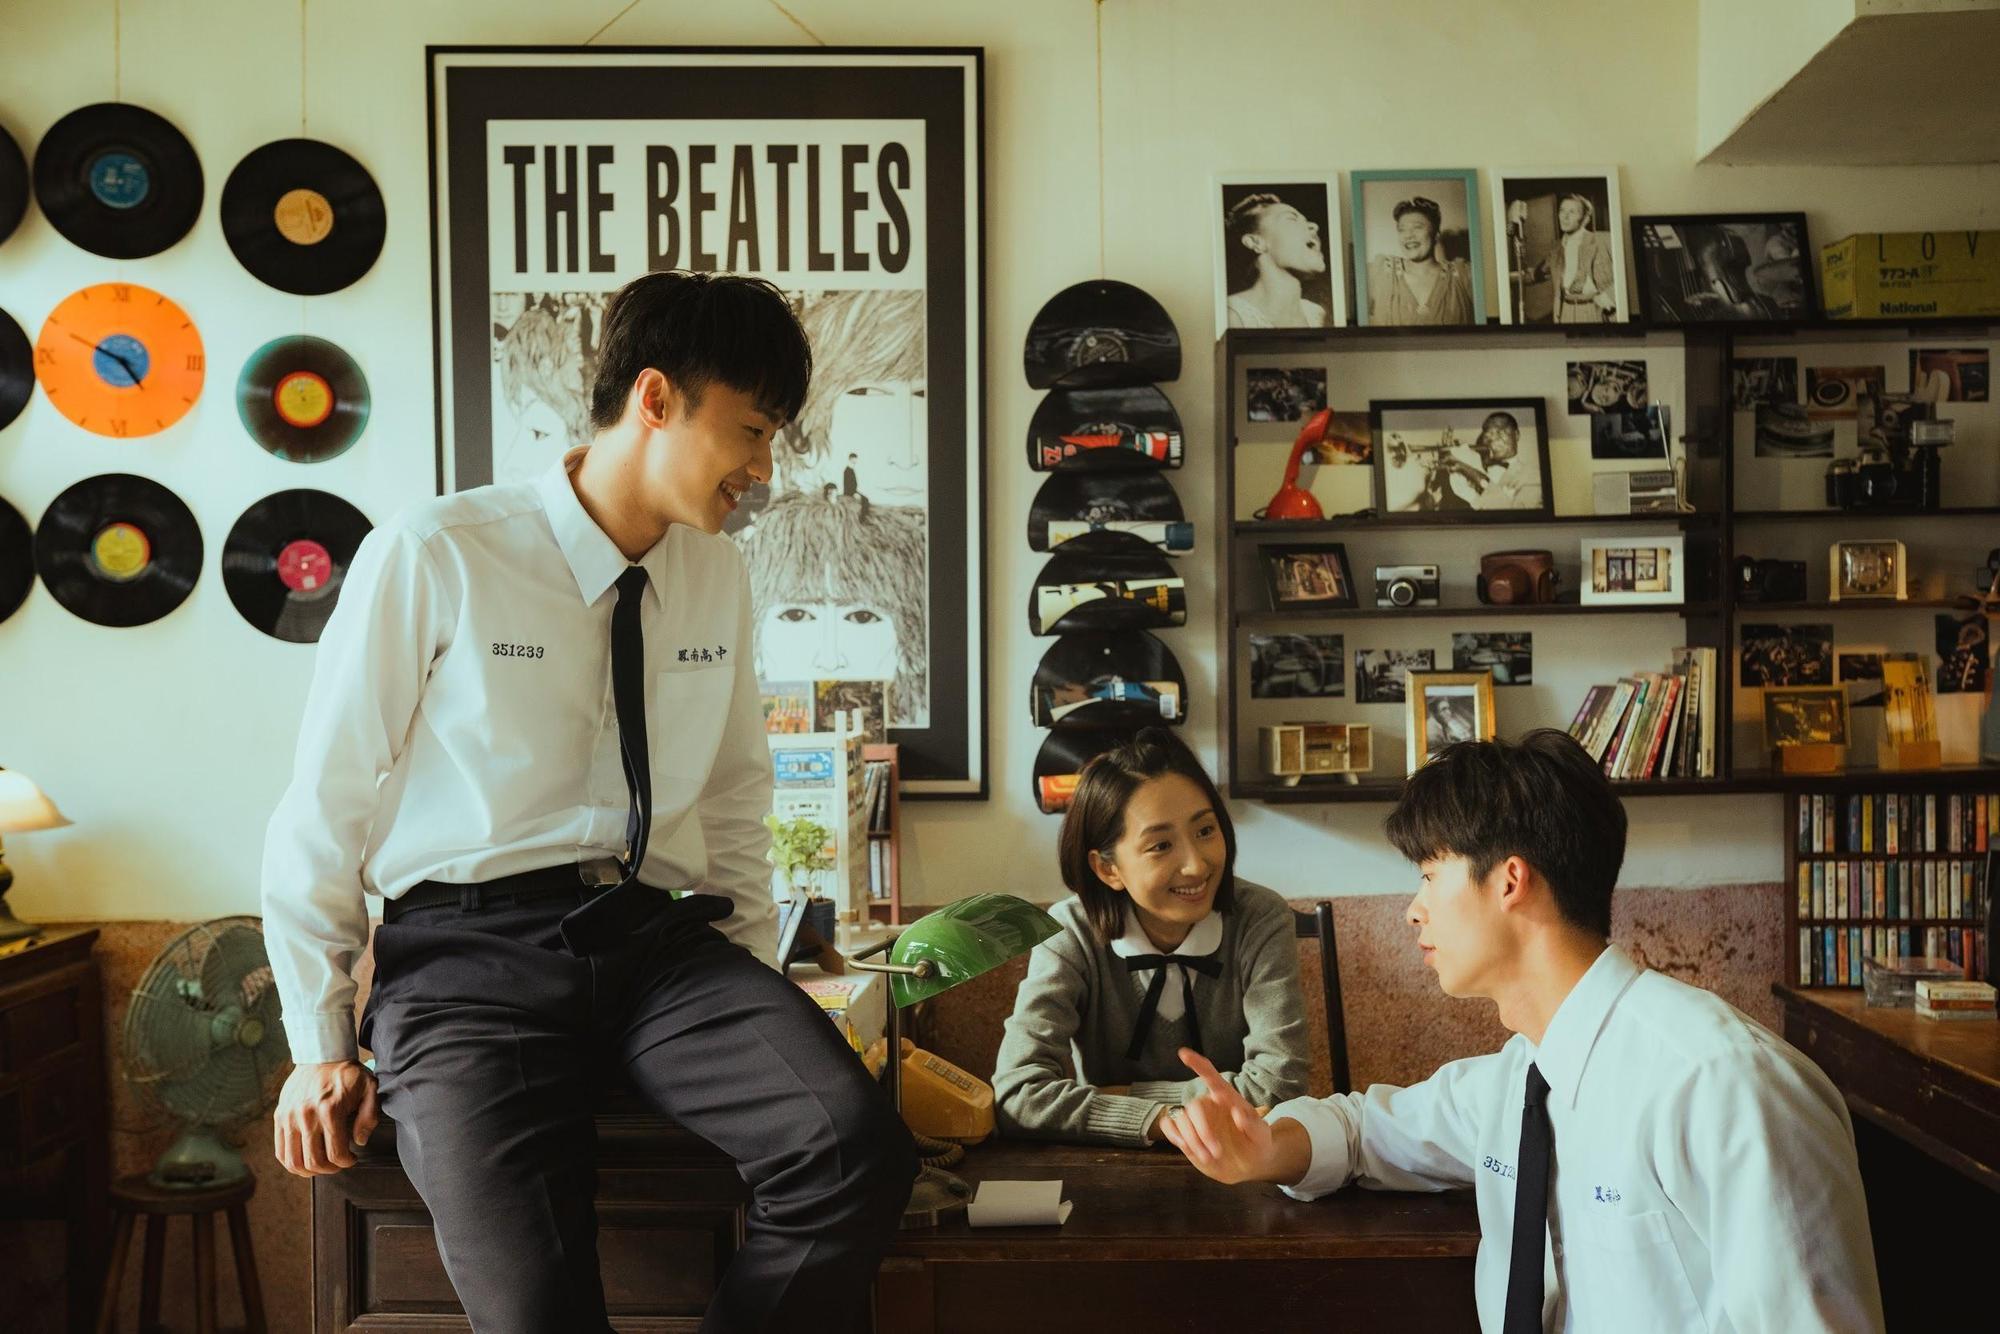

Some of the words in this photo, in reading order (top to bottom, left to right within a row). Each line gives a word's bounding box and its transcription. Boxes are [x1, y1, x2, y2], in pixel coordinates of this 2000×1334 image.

[504, 145, 616, 273] THE
[646, 141, 911, 273] BEATLES
[1880, 302, 1938, 315] National
[492, 642, 545, 659] 351239
